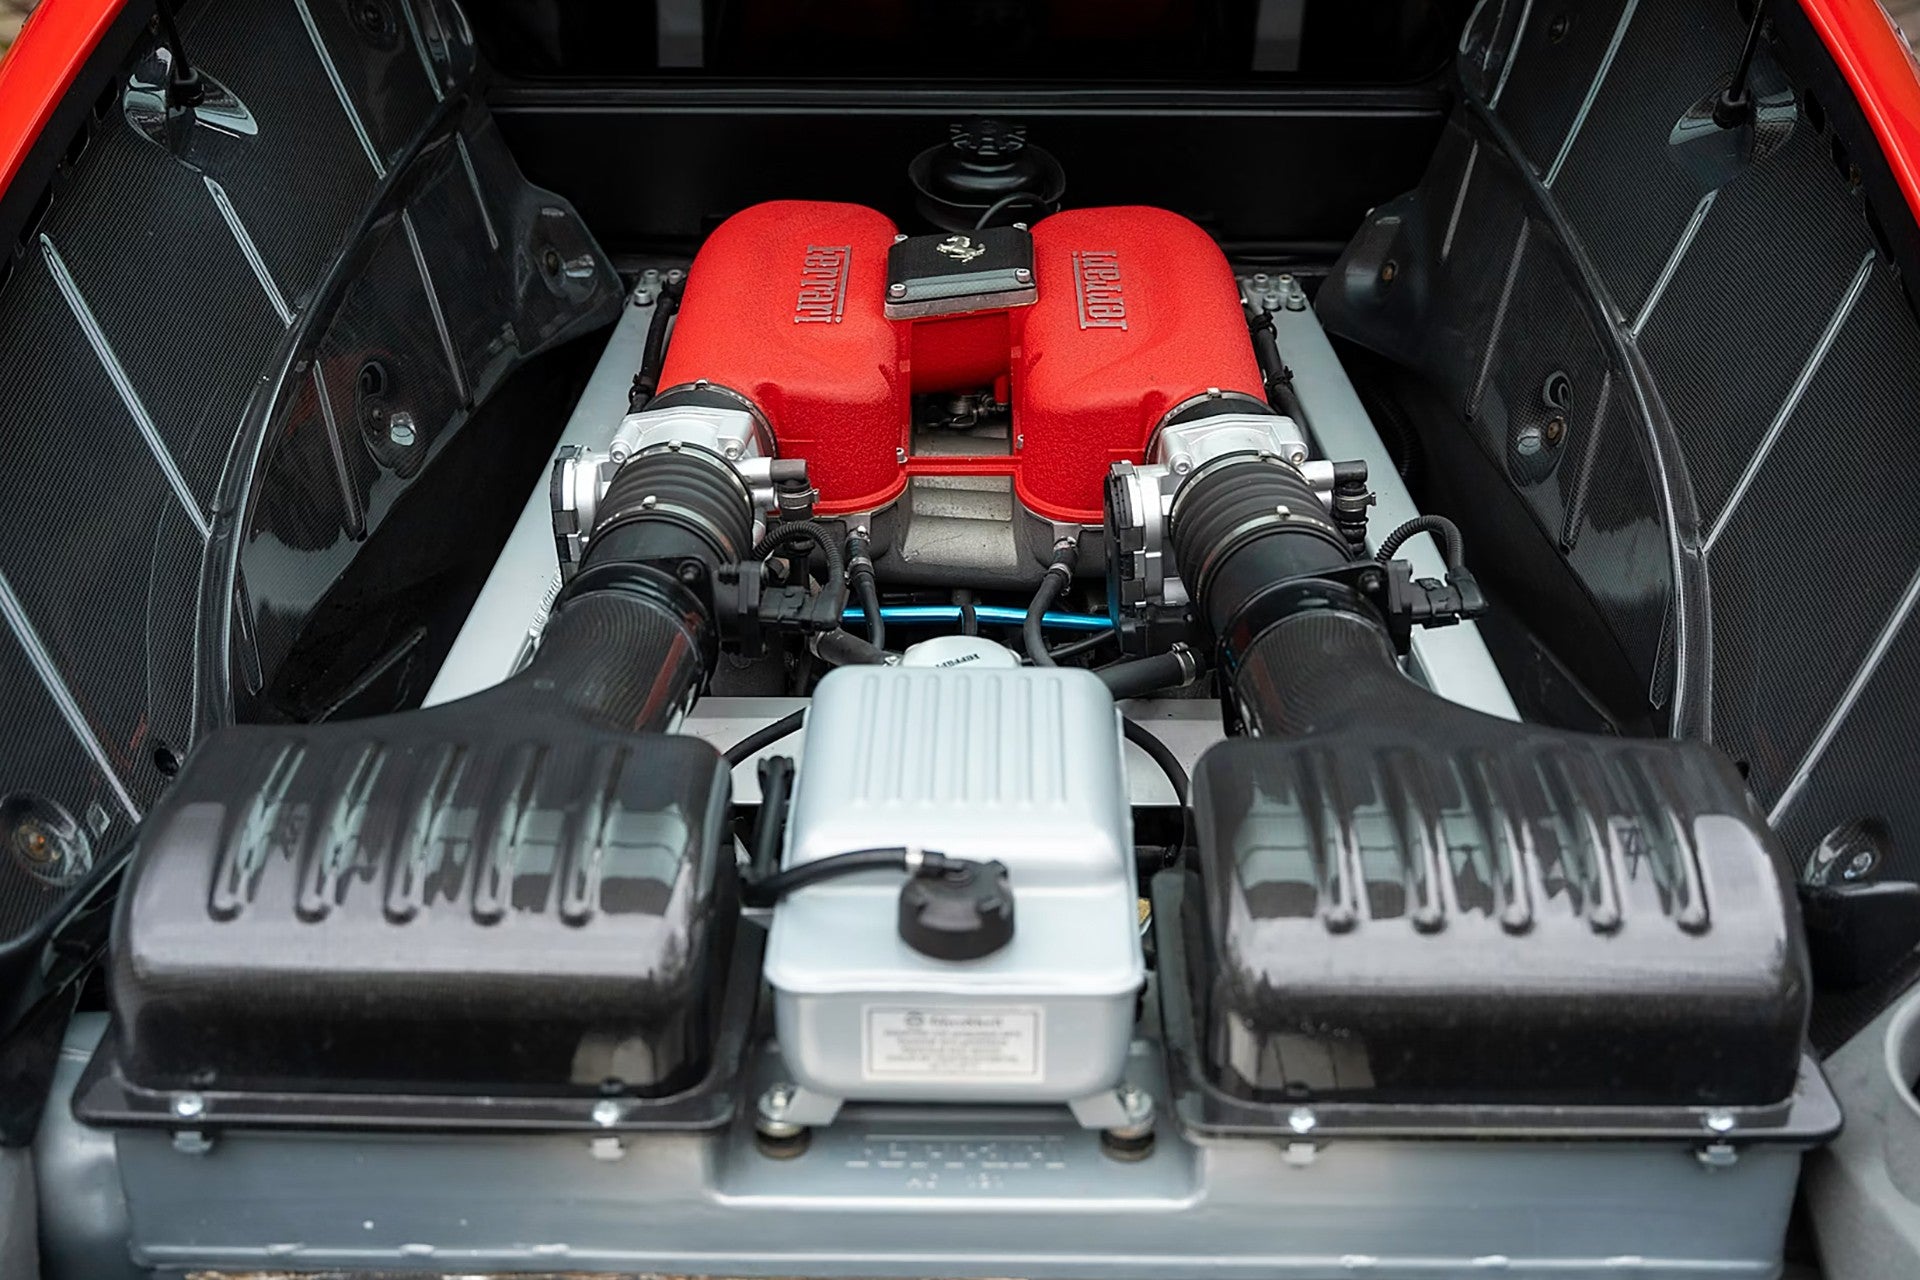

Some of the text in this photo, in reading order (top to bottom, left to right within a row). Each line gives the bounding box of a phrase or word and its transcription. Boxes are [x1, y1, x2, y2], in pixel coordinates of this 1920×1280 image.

[794, 245, 851, 323] Ferrari
[1072, 251, 1127, 330] Ferrari
[935, 653, 980, 668] Ferrar
